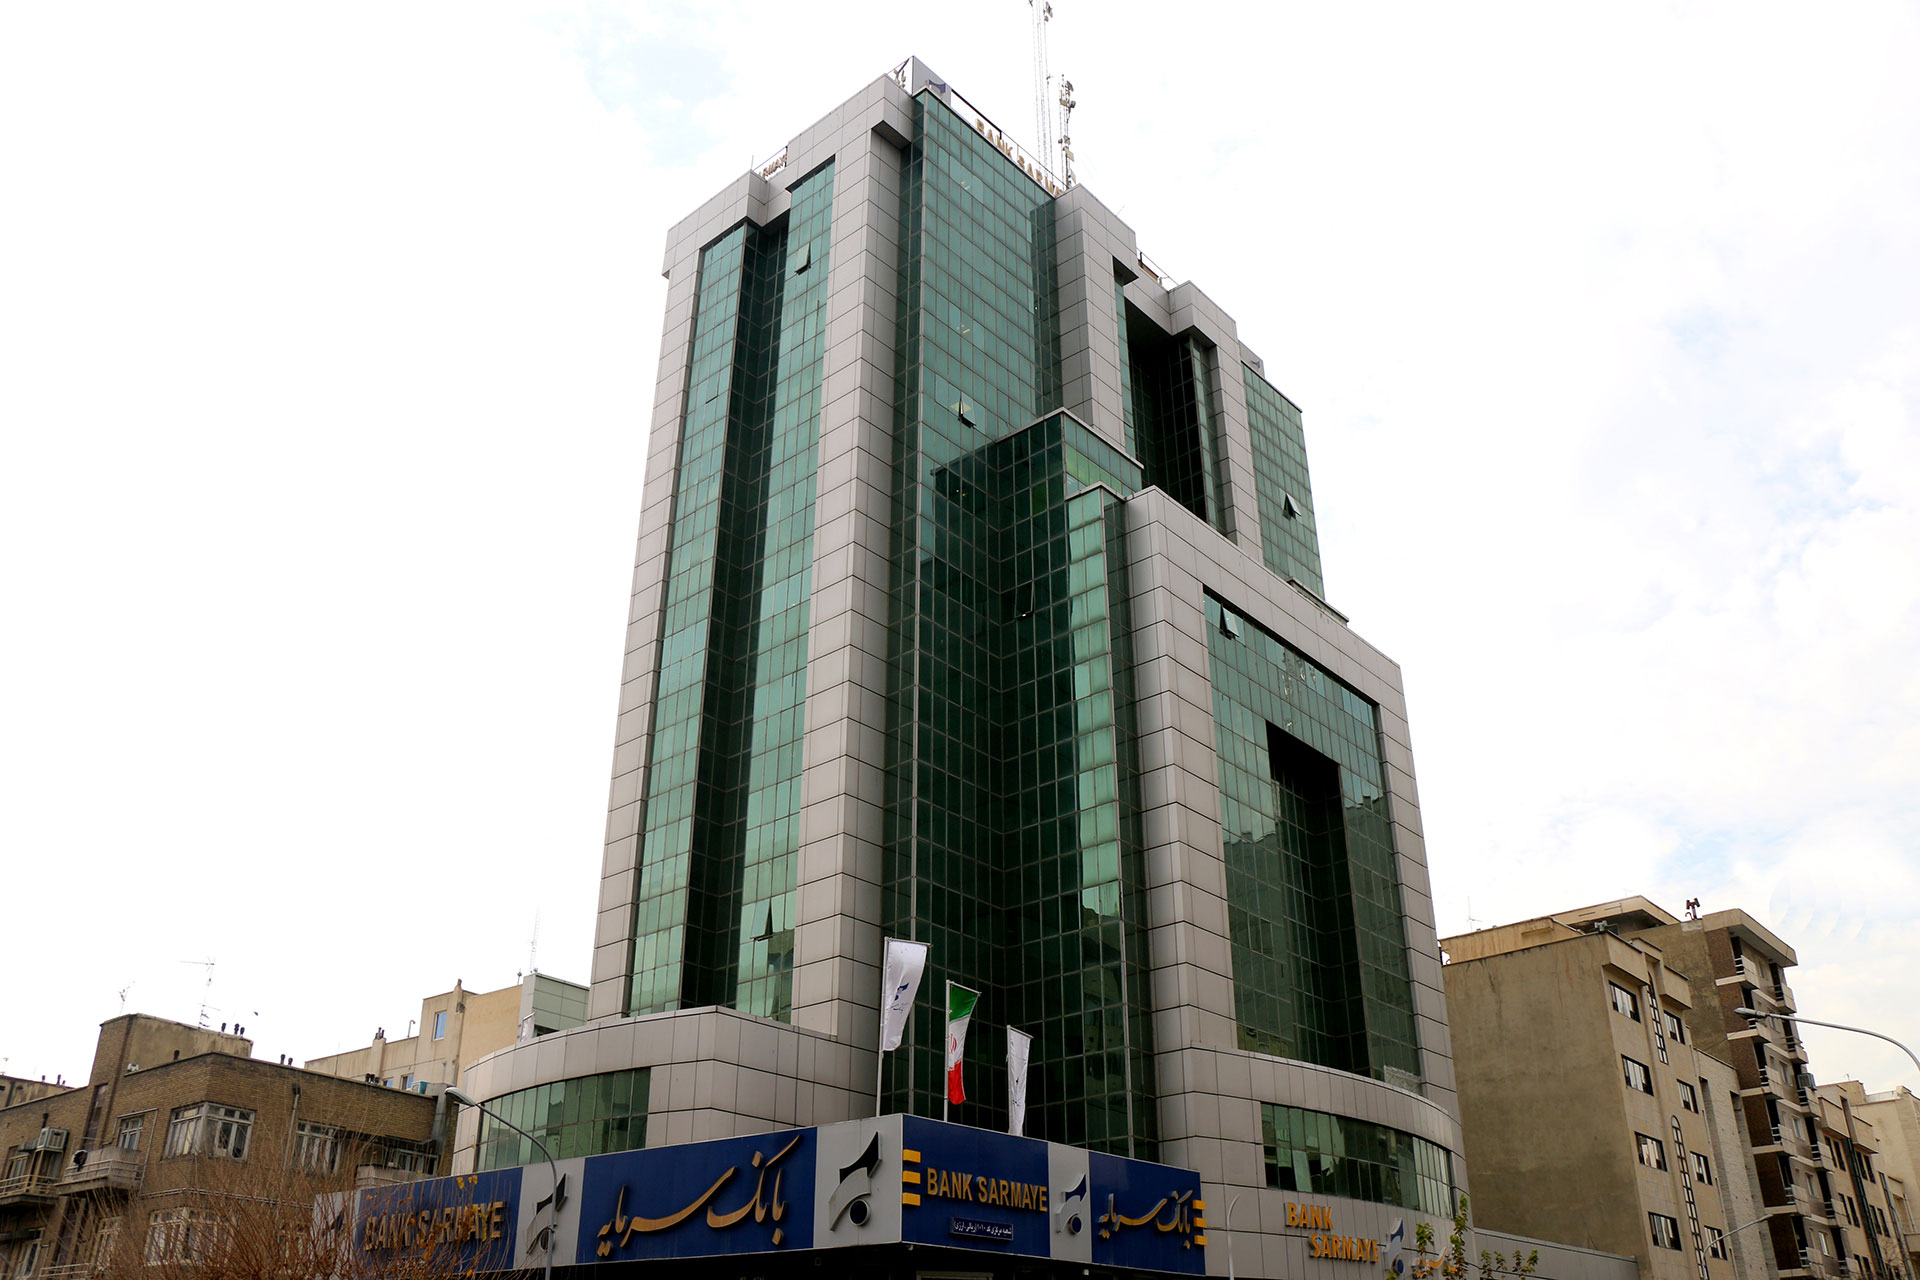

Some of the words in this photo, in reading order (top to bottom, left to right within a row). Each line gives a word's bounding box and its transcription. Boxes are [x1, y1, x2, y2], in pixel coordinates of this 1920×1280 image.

[976, 118, 1013, 160] BANK
[597, 1166, 737, 1257] سرمایه
[706, 1134, 800, 1246] بانک
[927, 1167, 973, 1201] BANK
[976, 1176, 1048, 1212] SARMAYE
[1098, 1193, 1168, 1240] سرمایه
[1154, 1190, 1193, 1250] بانک
[1286, 1202, 1334, 1230] BANK
[1310, 1232, 1380, 1262] SARMAYE
